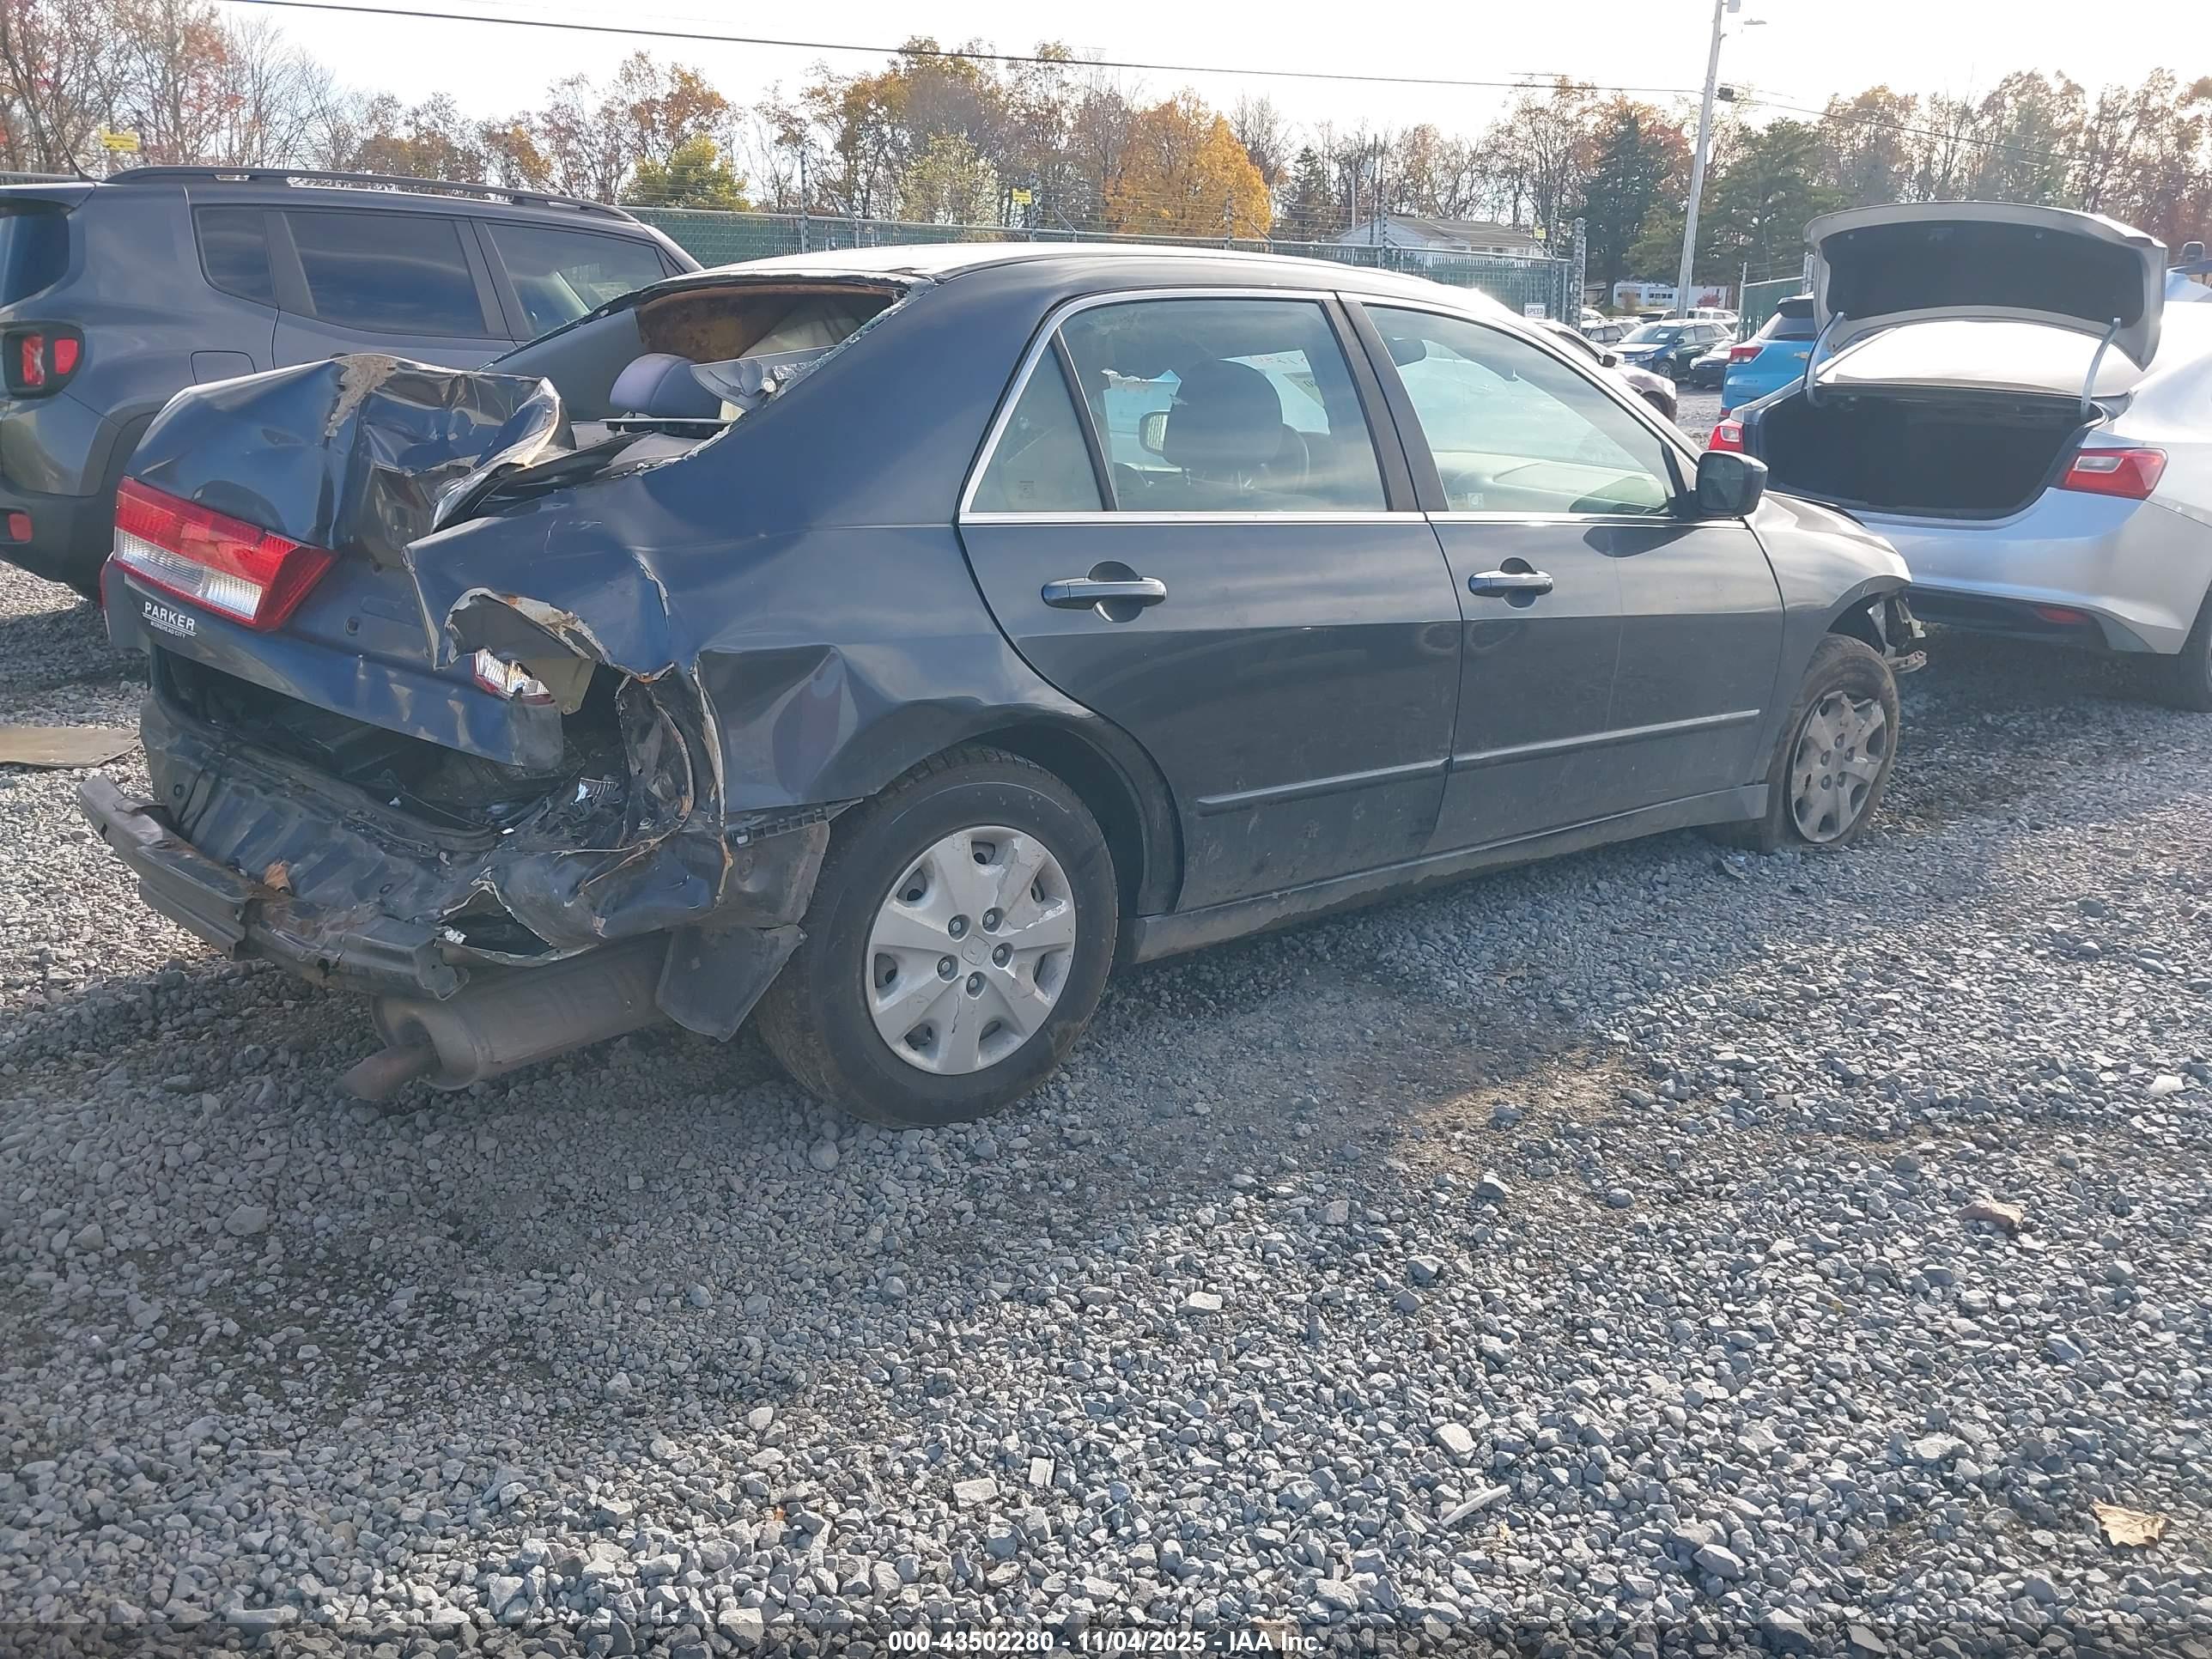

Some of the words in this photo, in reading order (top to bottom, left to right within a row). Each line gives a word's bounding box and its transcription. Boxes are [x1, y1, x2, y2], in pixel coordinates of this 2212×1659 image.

[144, 601, 195, 631] PARKER
[150, 621, 174, 635] MOREHEAD
[174, 629, 186, 639] CITY
